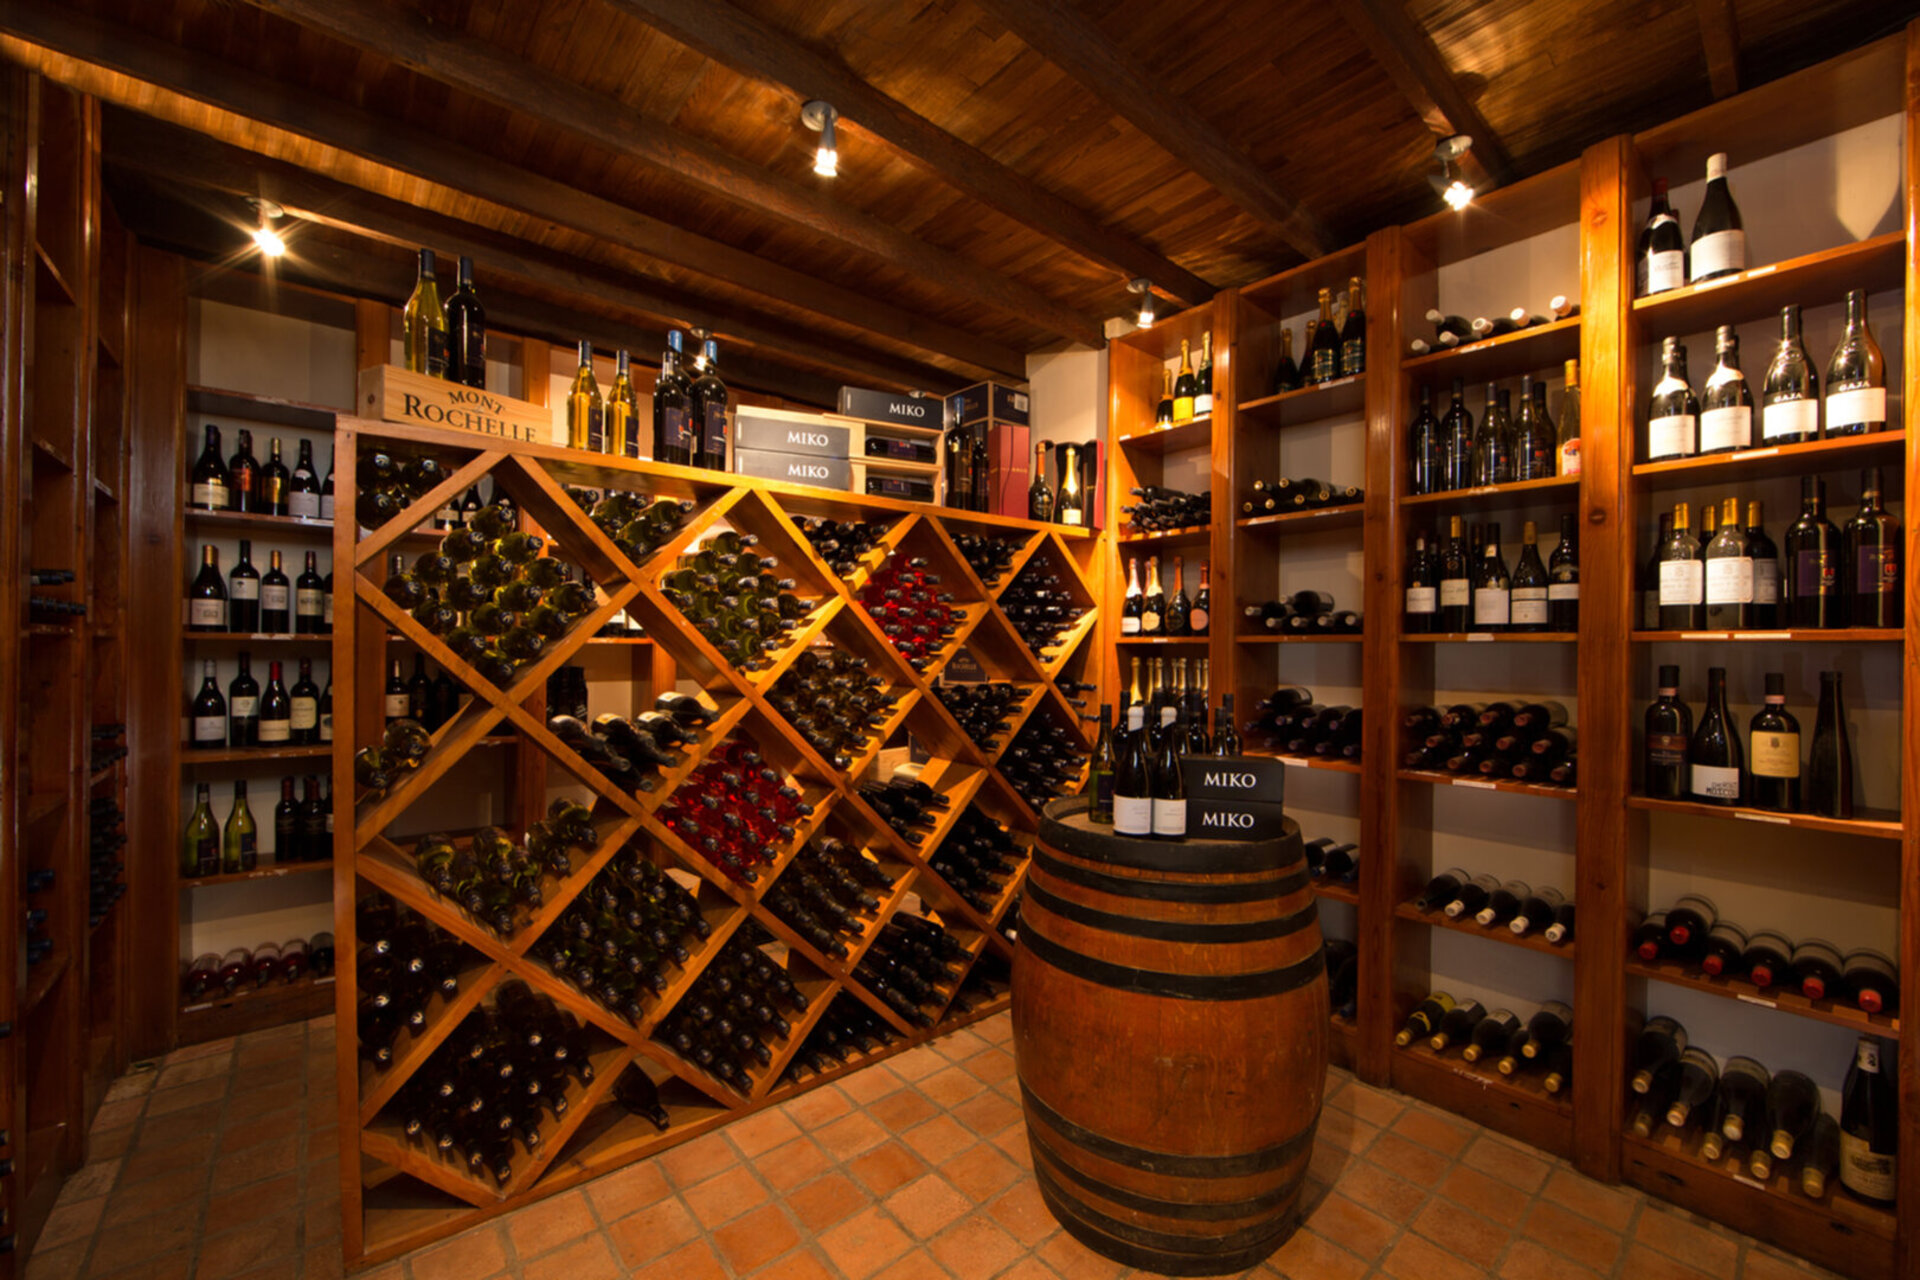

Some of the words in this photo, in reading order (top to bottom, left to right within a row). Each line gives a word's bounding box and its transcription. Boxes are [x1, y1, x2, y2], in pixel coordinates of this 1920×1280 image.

[448, 391, 505, 415] MONT
[889, 403, 925, 418] MIKO
[787, 431, 828, 447] MIKO
[787, 464, 829, 480] MIKO
[1204, 772, 1257, 789] MIKO
[1202, 811, 1254, 828] MIKO
